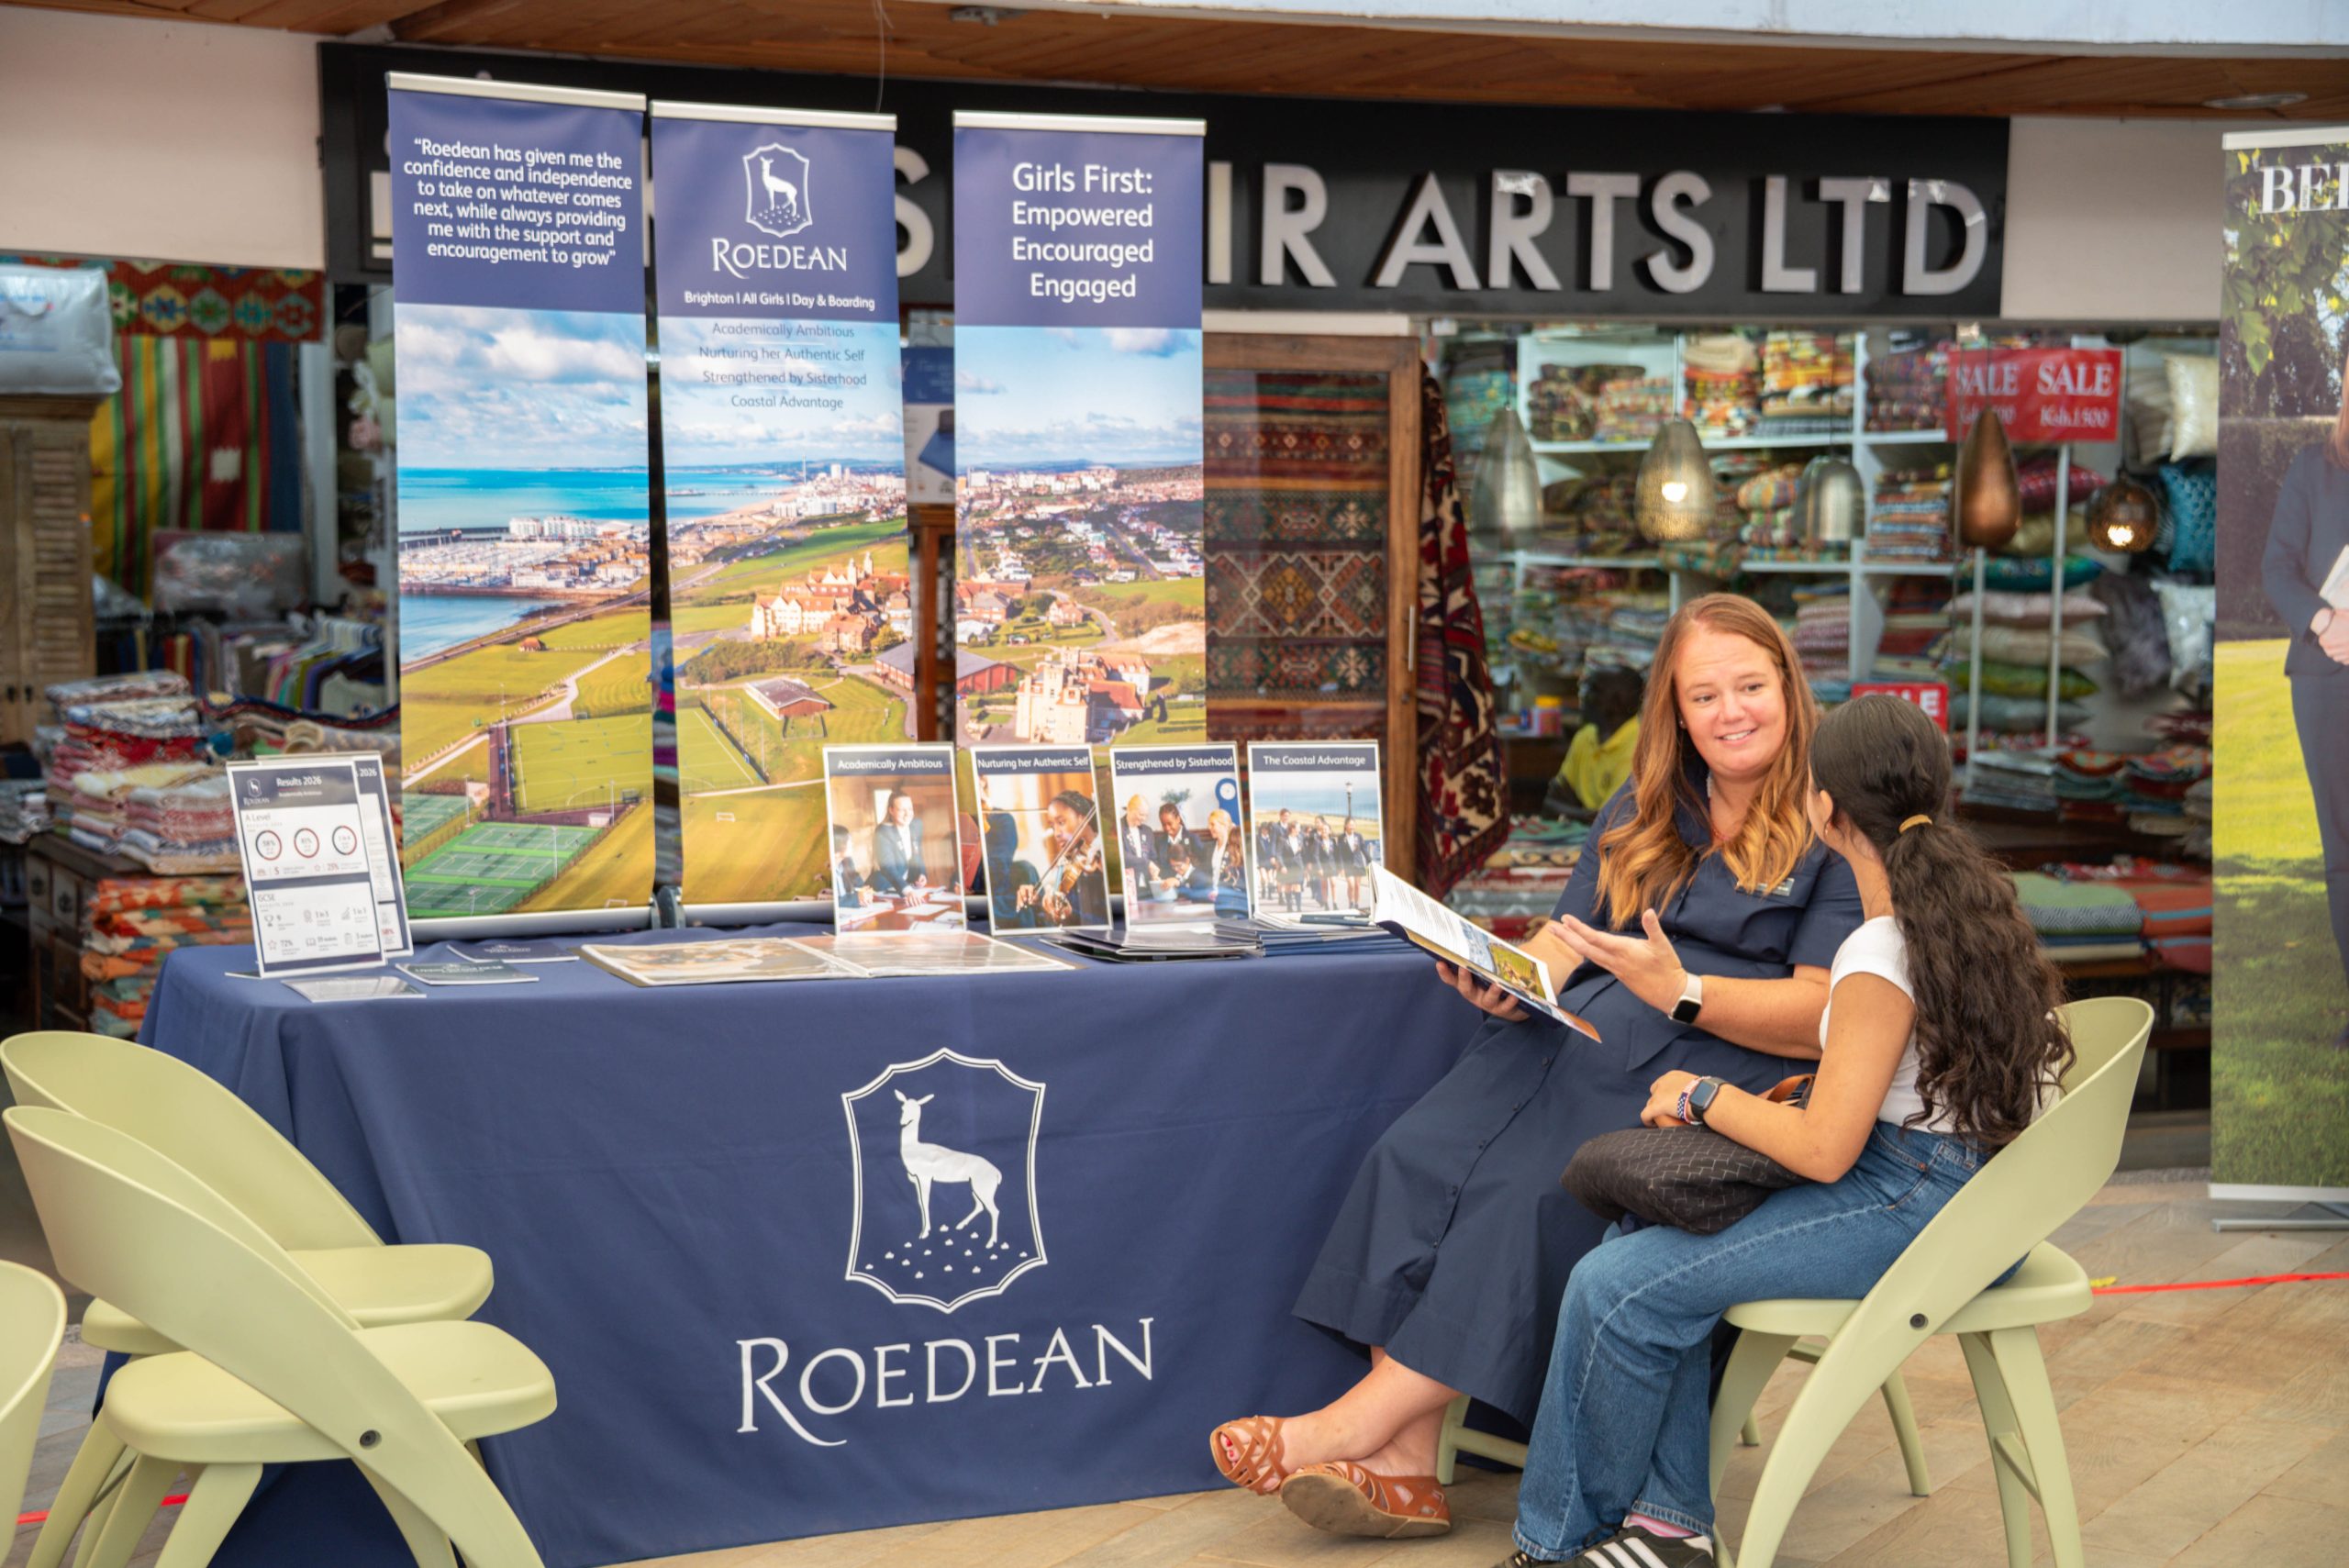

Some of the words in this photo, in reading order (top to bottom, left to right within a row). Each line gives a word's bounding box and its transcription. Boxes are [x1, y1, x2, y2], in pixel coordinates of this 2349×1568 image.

[494, 143, 522, 162] has
[525, 148, 565, 168] given
[569, 154, 594, 168] me
[596, 152, 622, 170] the
[403, 159, 491, 180] confidence
[494, 164, 524, 183] and
[528, 168, 633, 190] independence
[1012, 161, 1075, 193] Girls
[1084, 164, 1153, 195] First:
[417, 180, 435, 196] to
[439, 182, 473, 199] take
[476, 185, 496, 200] on
[500, 185, 570, 206] whatever
[573, 191, 622, 208] comes
[414, 201, 453, 220] next,
[457, 203, 497, 220] while
[501, 205, 552, 225] always
[555, 210, 627, 232] providing
[1012, 200, 1153, 232] Empowered
[428, 222, 453, 238] me
[457, 222, 491, 239] with
[494, 225, 520, 241] the
[523, 228, 581, 247] support
[584, 230, 615, 247] and
[1375, 170, 1717, 295] ARTS
[1761, 174, 1989, 296] LTD
[427, 241, 548, 264] encouragement
[551, 249, 568, 264] to
[711, 238, 847, 279] ROEDEAN
[1012, 237, 1154, 269] Encouraged
[685, 291, 734, 306] Brighton
[743, 293, 757, 305] All
[760, 293, 785, 306] Girls
[793, 295, 815, 309] Day
[818, 295, 827, 306] &
[829, 295, 875, 311] Boarding
[1030, 272, 1137, 304] Engaged
[712, 323, 793, 338] Academically
[796, 324, 855, 338] Ambitious
[699, 346, 758, 361] Nurturing
[762, 348, 781, 360] her
[785, 349, 841, 361] Authentic
[845, 350, 865, 361] Self
[703, 371, 786, 385] Strengthened
[789, 372, 803, 385] by
[806, 372, 867, 385] Sisterhood
[2037, 361, 2114, 397] SALE
[731, 395, 776, 408] Coastal
[780, 395, 843, 410] Advantage
[837, 759, 896, 772] Academically
[898, 758, 943, 770] Ambitious
[977, 758, 1017, 770] Nurturing
[1019, 758, 1032, 768] her
[1033, 757, 1072, 768] Authentic
[1074, 756, 1089, 767] Self
[1116, 759, 1174, 772] Strengthened
[1175, 758, 1186, 769] by
[1188, 756, 1234, 767] Sisterhood
[1264, 755, 1280, 766] The
[1282, 755, 1316, 766] Coastal
[1317, 755, 1366, 766] Advantage
[737, 1318, 1153, 1446] ROEDEAN
